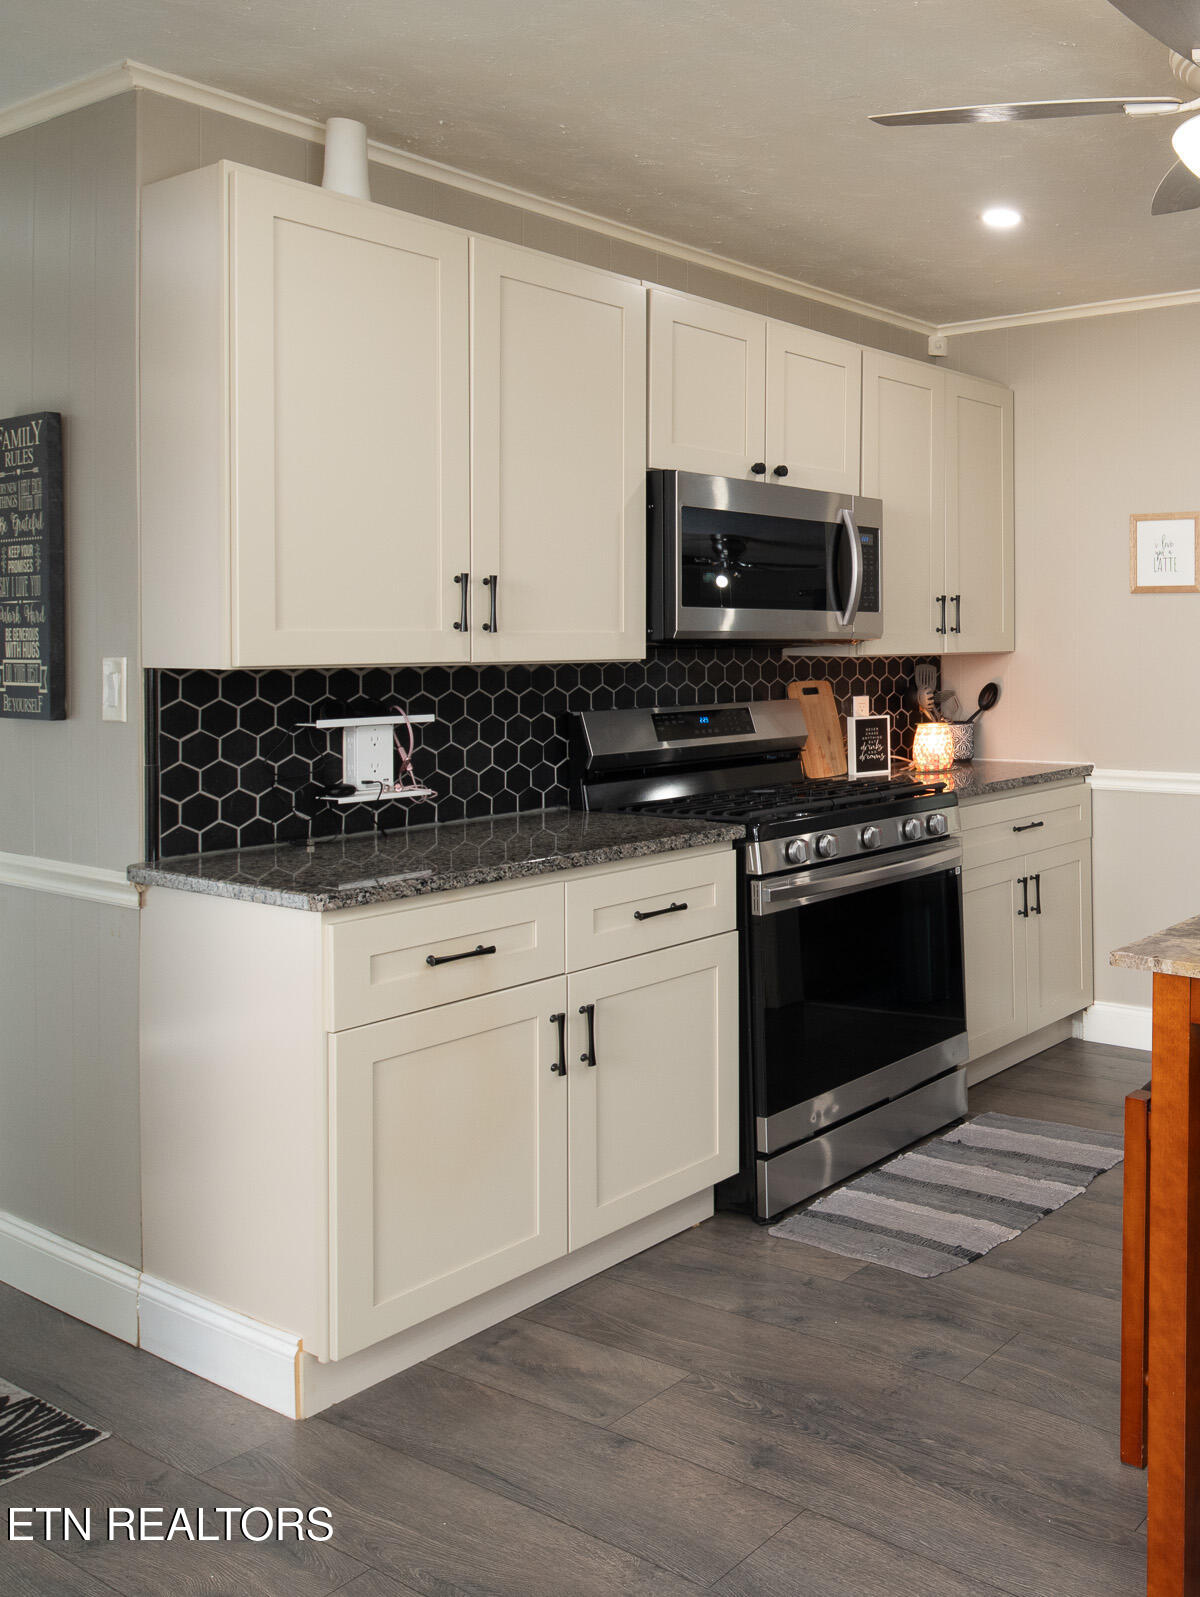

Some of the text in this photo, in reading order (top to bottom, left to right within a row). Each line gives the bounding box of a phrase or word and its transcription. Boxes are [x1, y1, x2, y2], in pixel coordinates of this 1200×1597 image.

[5, 449, 34, 467] RULES
[6, 627, 39, 640] BE GENEROUS
[5, 641, 39, 658] WITH HUGS
